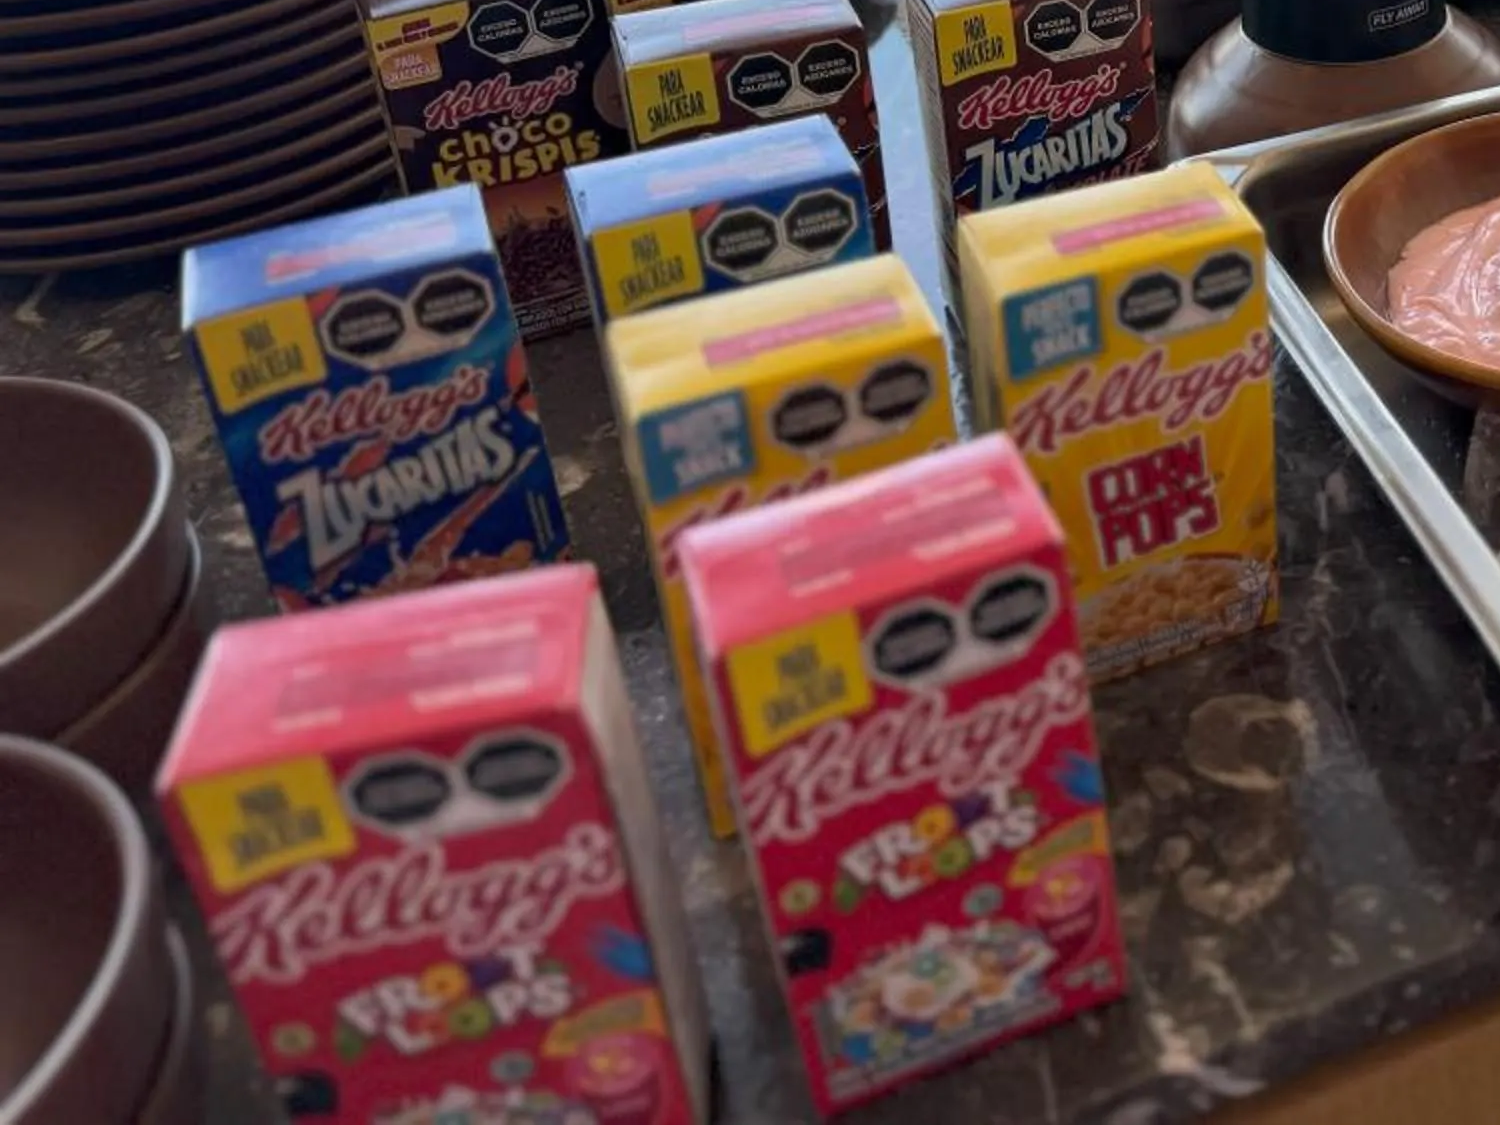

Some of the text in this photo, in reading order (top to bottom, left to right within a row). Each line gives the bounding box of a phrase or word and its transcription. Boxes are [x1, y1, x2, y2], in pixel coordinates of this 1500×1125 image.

[963, 14, 987, 43] PARA
[1373, 0, 1426, 26] FLY AWAY
[658, 66, 685, 94] PARA
[951, 37, 1006, 76] SNACKEAR
[424, 63, 580, 131] Kellogg's
[647, 90, 707, 127] SNACKEAR
[958, 63, 1122, 130] Kellogg's
[431, 129, 600, 188] KRISPIS
[259, 363, 492, 463] Kellogg's
[1007, 330, 1274, 457] Kellogg's
[1087, 432, 1208, 515] CORN
[1100, 481, 1222, 568] POPS
[741, 651, 1088, 845] Kellogg's
[208, 823, 626, 986] Kellogg's
